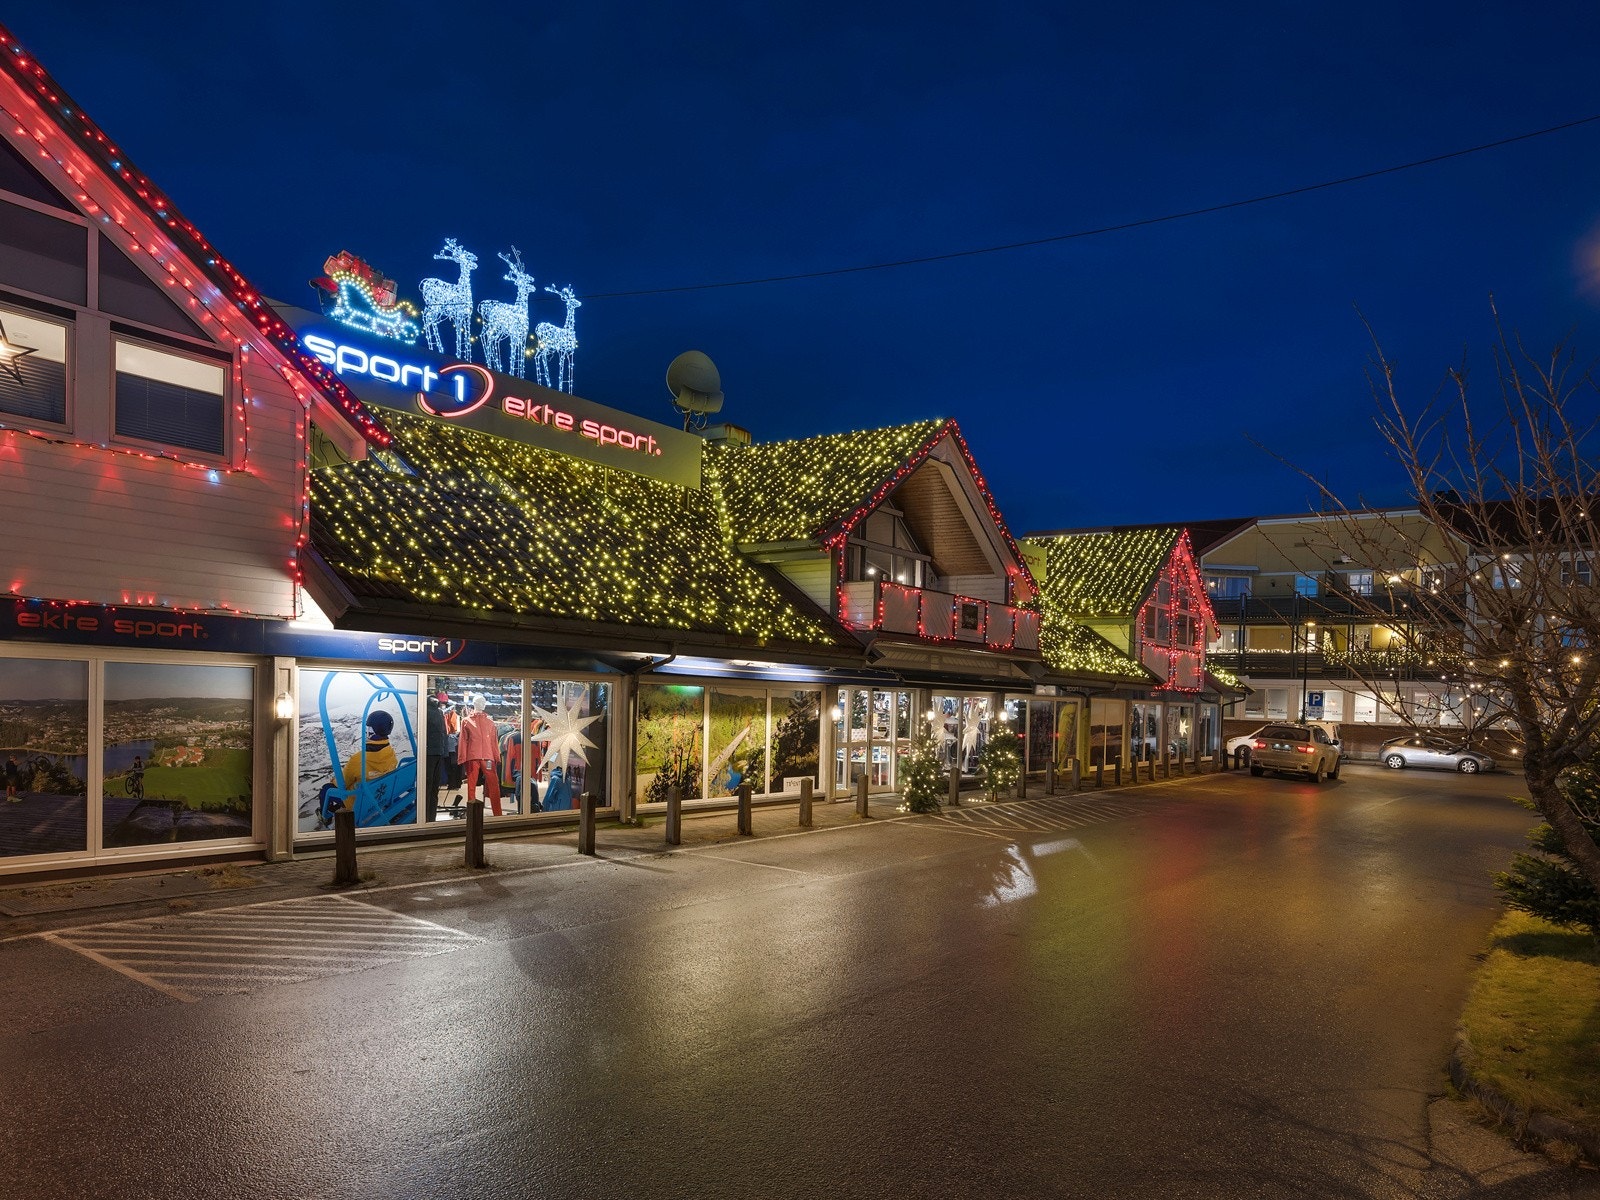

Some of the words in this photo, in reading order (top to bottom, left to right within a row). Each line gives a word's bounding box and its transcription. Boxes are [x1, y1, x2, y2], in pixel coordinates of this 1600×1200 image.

[304, 334, 438, 392] sport
[454, 374, 465, 402] 1
[502, 396, 574, 431] ekte
[17, 612, 99, 631] ekte
[378, 638, 439, 654] sport
[445, 640, 452, 654] 1
[1312, 694, 1321, 705] P
